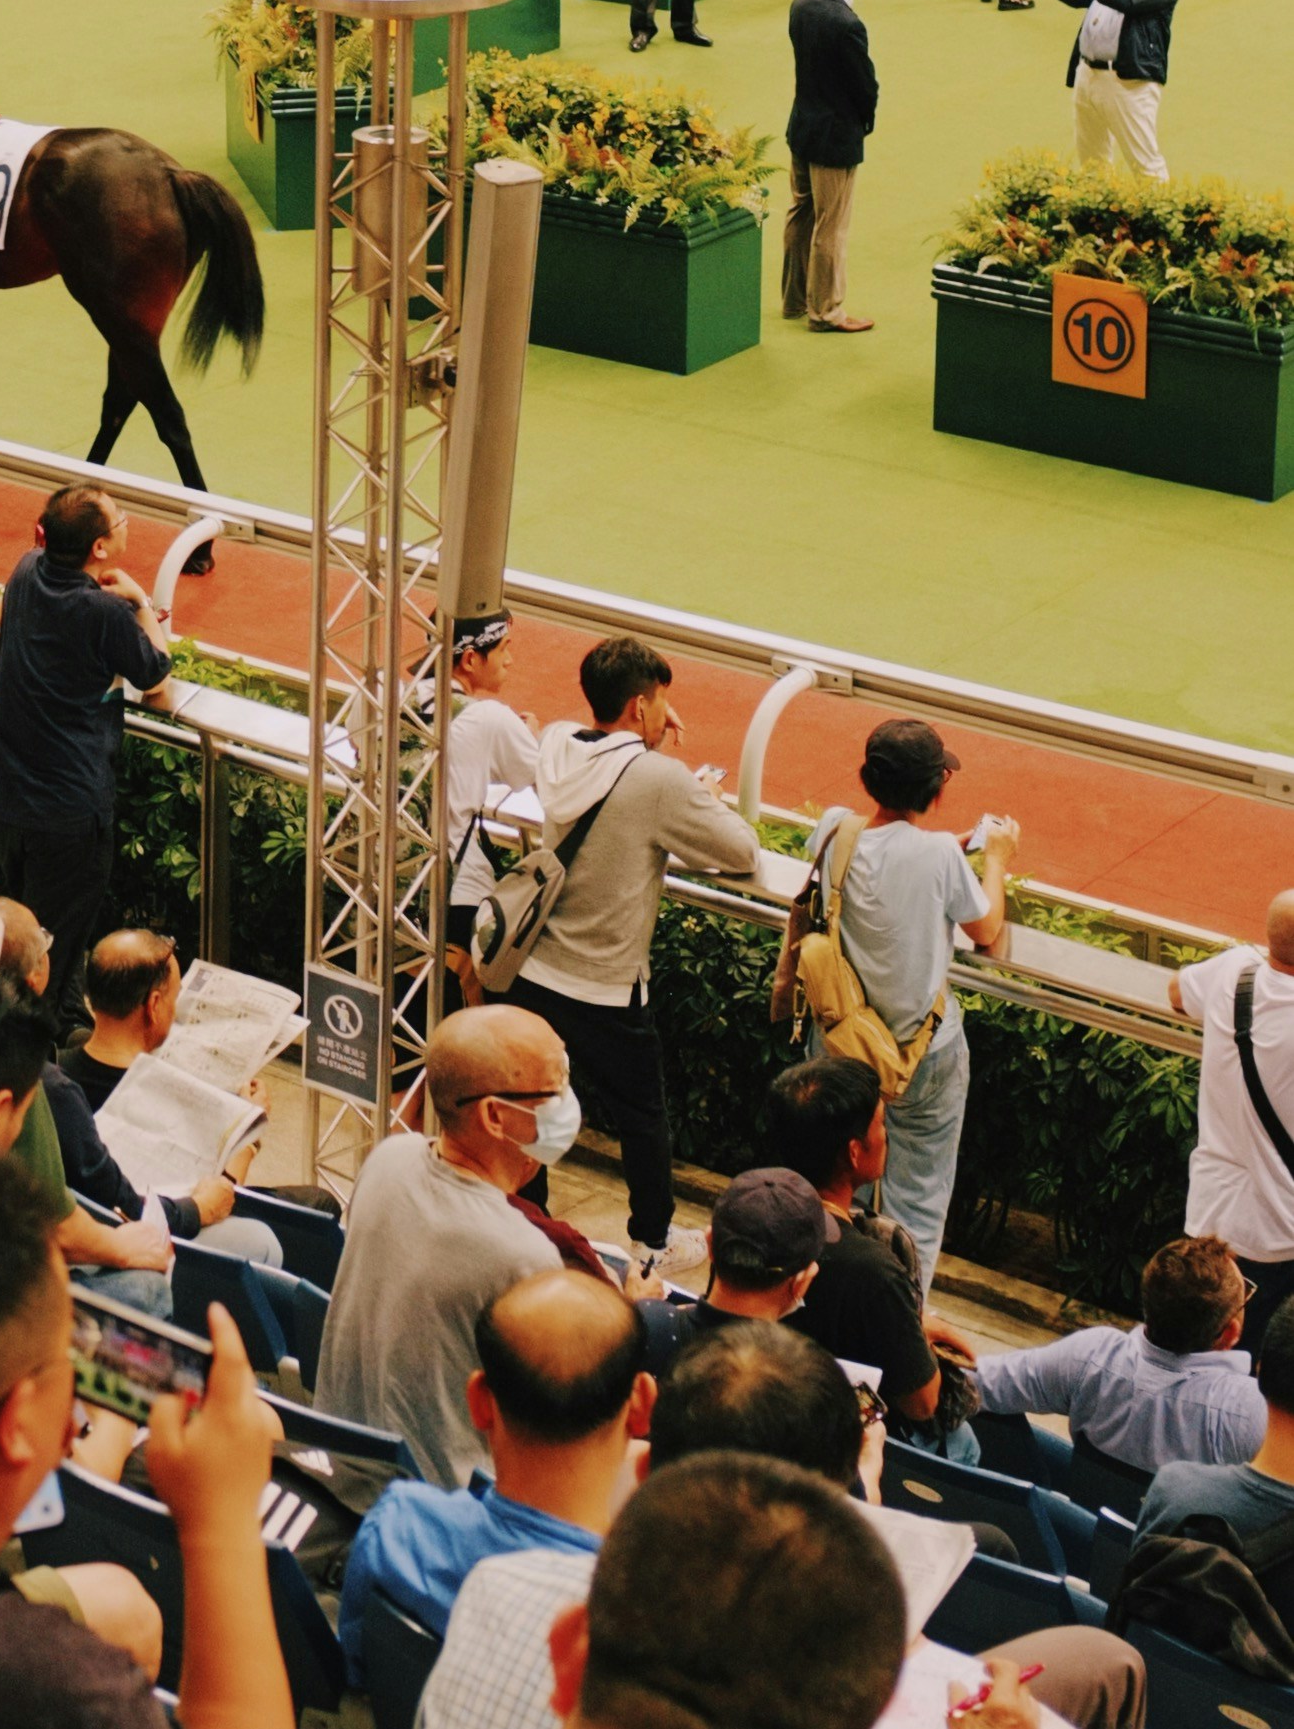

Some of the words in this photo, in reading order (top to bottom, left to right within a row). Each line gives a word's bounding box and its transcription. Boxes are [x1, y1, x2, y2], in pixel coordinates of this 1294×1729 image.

[1072, 313, 1126, 361] 10
[316, 1055, 328, 1066] ON
[328, 1059, 367, 1080] STAIRCASE
[318, 1046, 330, 1058] NO
[330, 1051, 366, 1070] STANDING
